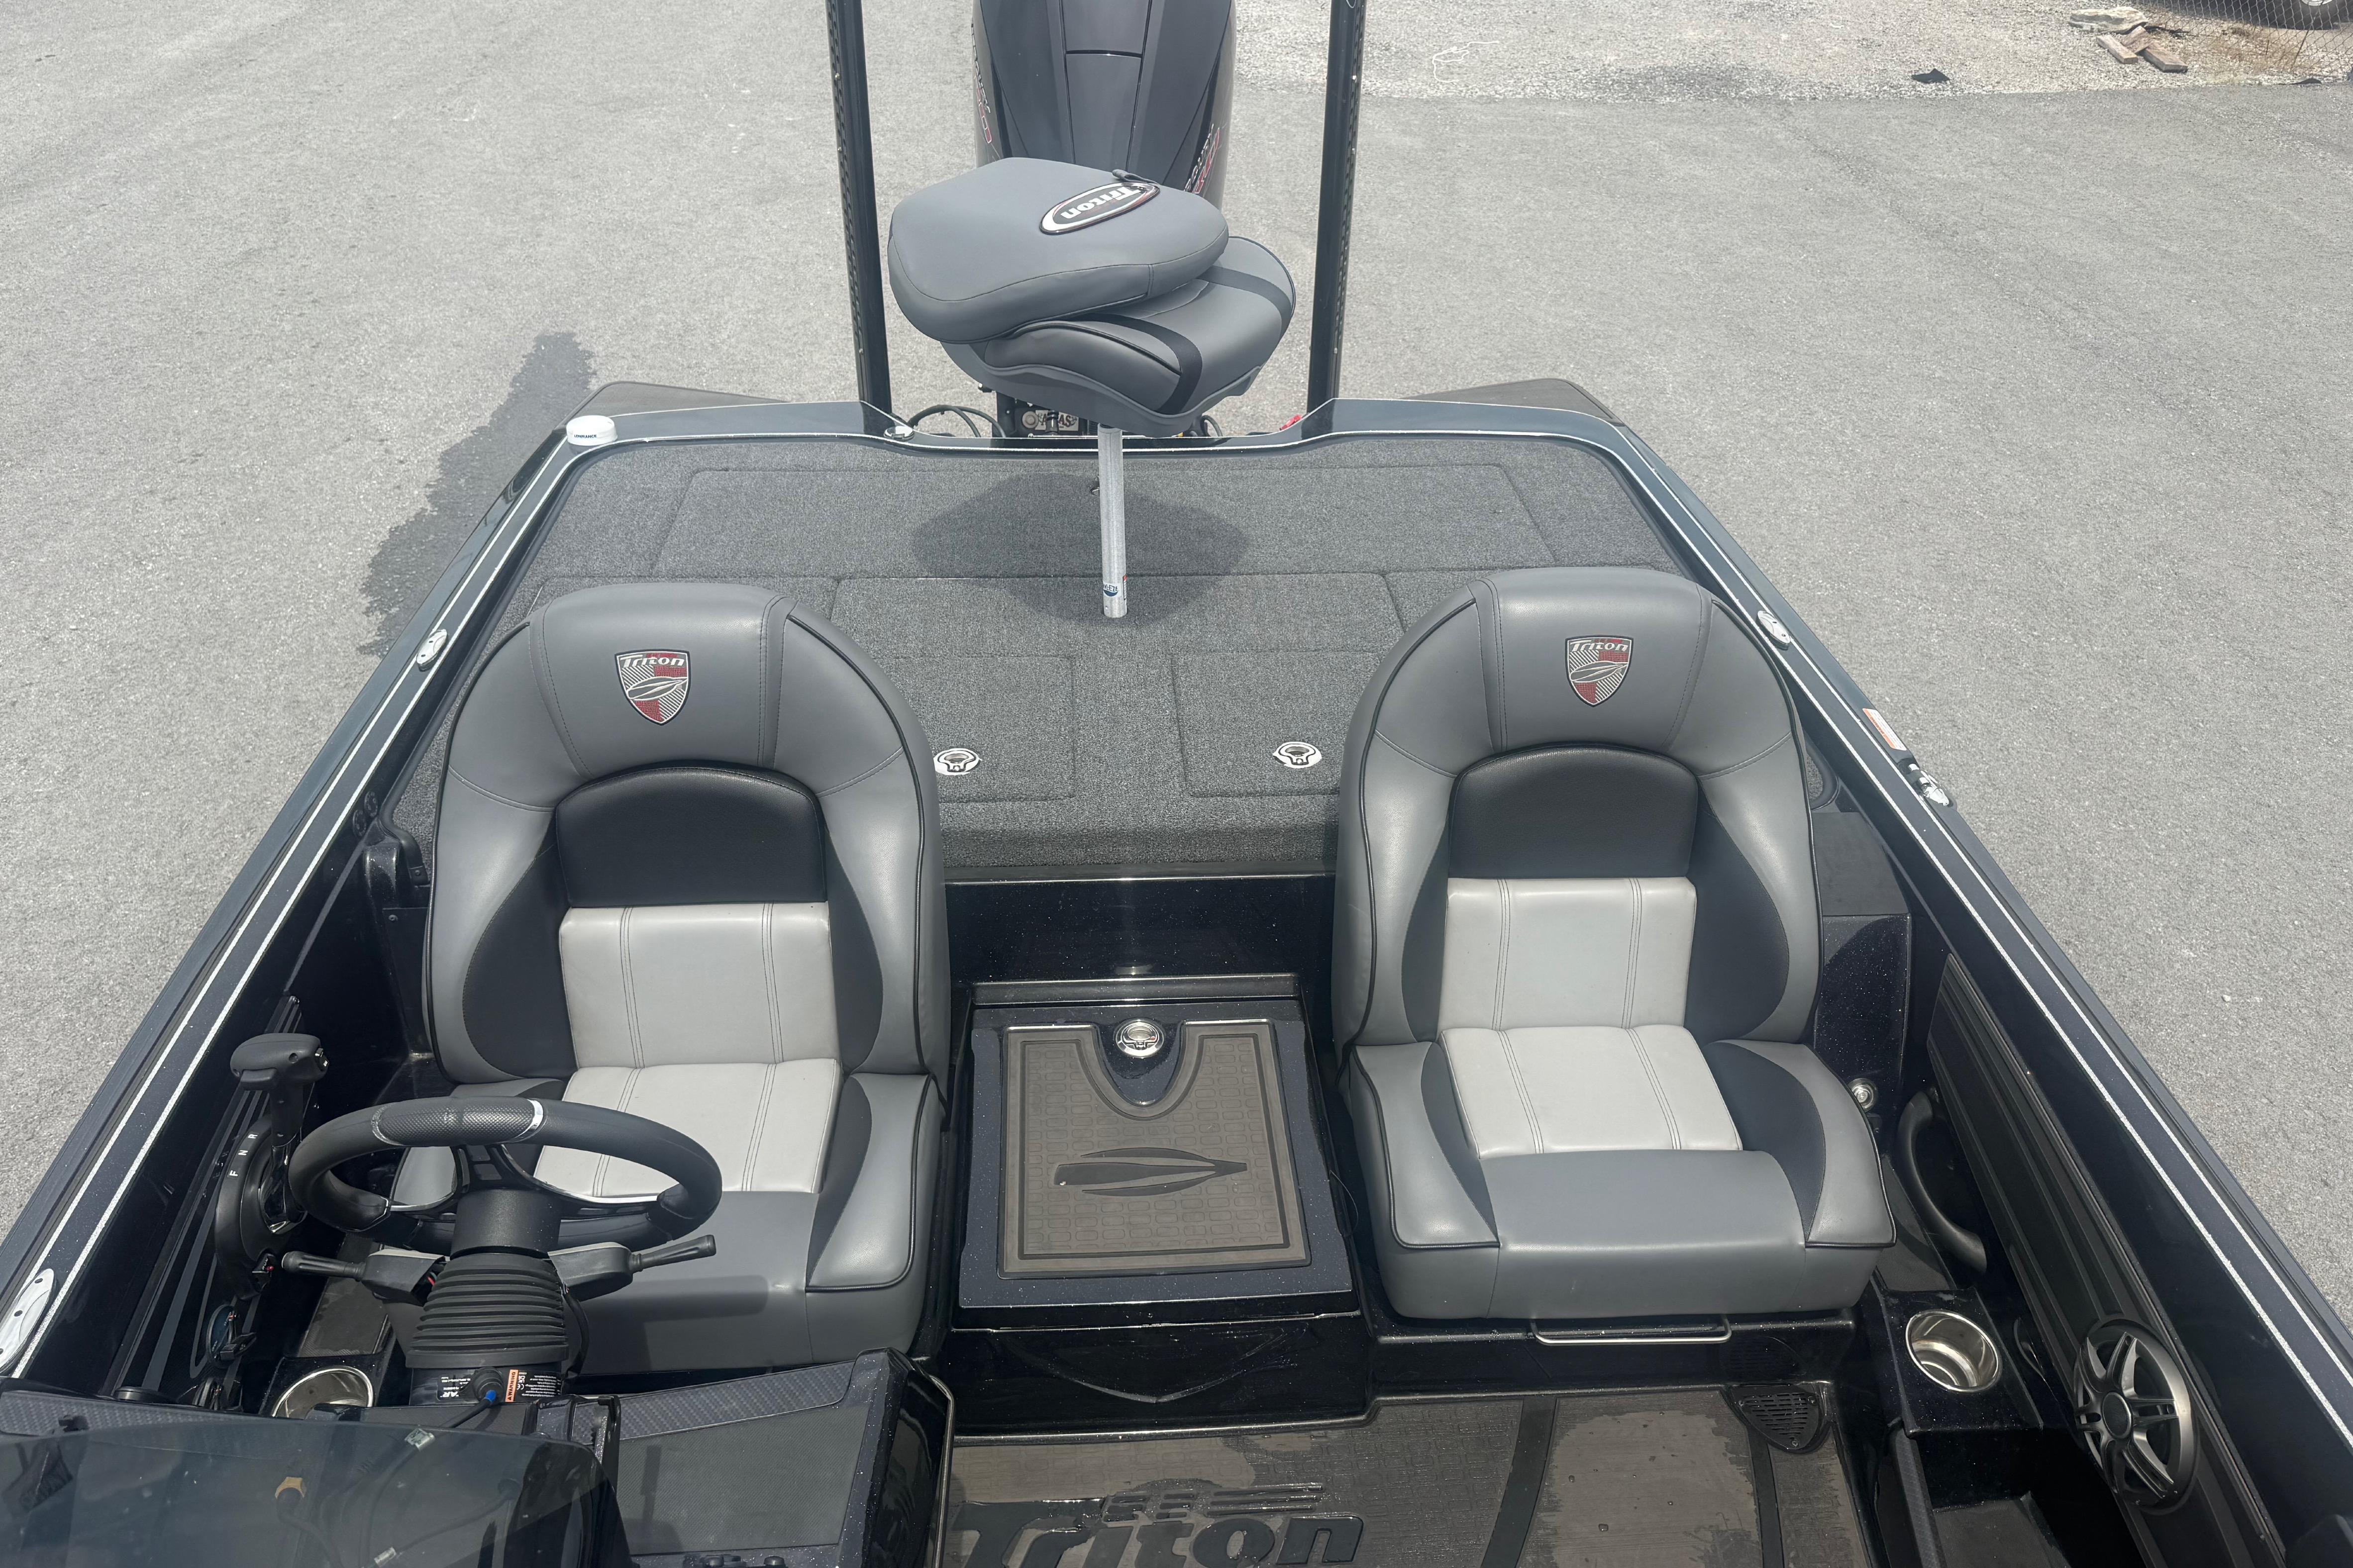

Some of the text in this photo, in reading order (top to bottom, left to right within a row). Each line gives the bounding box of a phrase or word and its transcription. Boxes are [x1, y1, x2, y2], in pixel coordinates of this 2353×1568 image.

[1060, 186, 1141, 219] Triton
[1040, 413, 1072, 427] AAS
[1570, 640, 1629, 652] Triton
[620, 654, 685, 668] Triton
[951, 1498, 1364, 1568] Triton
